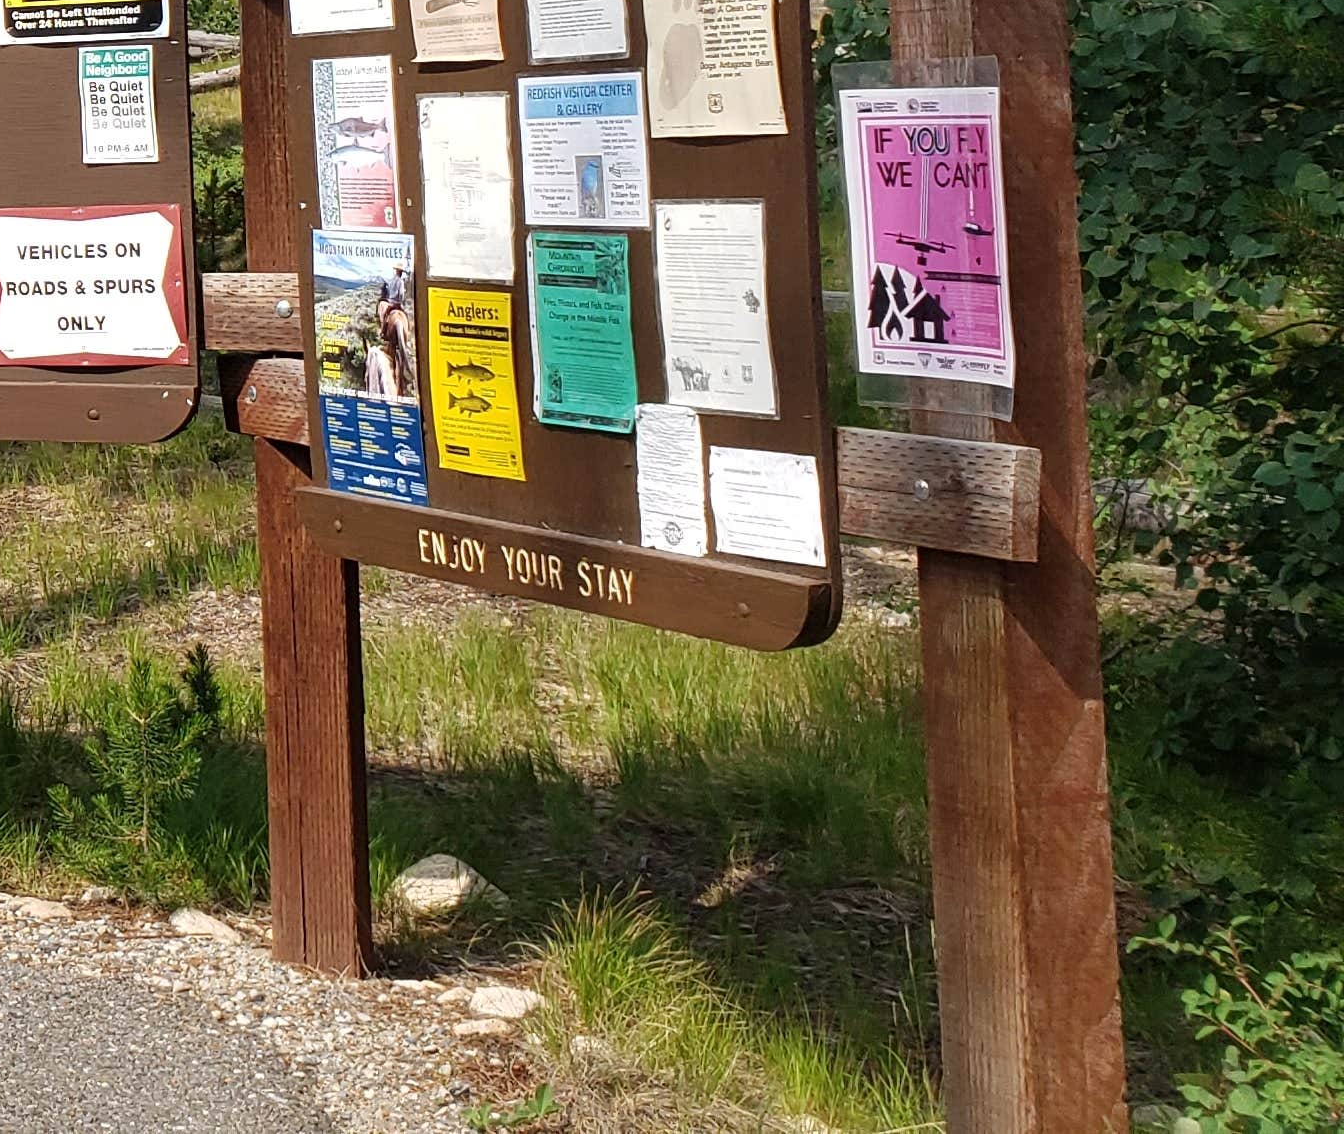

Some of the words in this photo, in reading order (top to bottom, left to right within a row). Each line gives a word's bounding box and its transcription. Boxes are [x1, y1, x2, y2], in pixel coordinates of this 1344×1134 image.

[12, 11, 44, 20] Cannot
[47, 9, 60, 18] Be
[62, 8, 82, 17] Left
[84, 5, 140, 16] Unattended
[15, 21, 36, 30] Over
[39, 19, 52, 28] 24
[55, 18, 84, 27] Hours
[86, 16, 138, 26] Thereafter
[86, 53, 100, 63] Be
[103, 52, 112, 63] A
[115, 51, 146, 62] Good
[86, 64, 137, 77] Neighbor
[89, 82, 105, 92] Be
[110, 81, 143, 91] Quiet
[528, 88, 561, 100] REDFISH
[564, 86, 597, 98] VISITOR
[599, 84, 631, 96] CENTER
[90, 94, 106, 104] Be
[111, 93, 144, 104] Quiet
[92, 107, 107, 116] Be
[112, 106, 145, 117] Quiet
[557, 105, 563, 115] &
[566, 103, 603, 115] GALLERY
[93, 119, 108, 129] Be
[113, 118, 146, 129] Quiet
[134, 144, 148, 152] AM
[874, 128, 893, 154] IF
[903, 127, 948, 153] YOU
[877, 162, 912, 187] WE
[934, 162, 988, 189] CAN'T
[17, 244, 108, 260] VEHICLES
[115, 243, 141, 258] ON
[319, 243, 353, 256] MOUNTAIN
[356, 245, 403, 259] CHRONICLES
[6, 281, 68, 296] ROADS
[75, 280, 86, 295] &
[94, 279, 156, 295] SPURS
[447, 300, 499, 322] Anglers:
[58, 316, 106, 331] ONLY
[501, 545, 563, 591] YOUR
[577, 557, 633, 605] STAY
